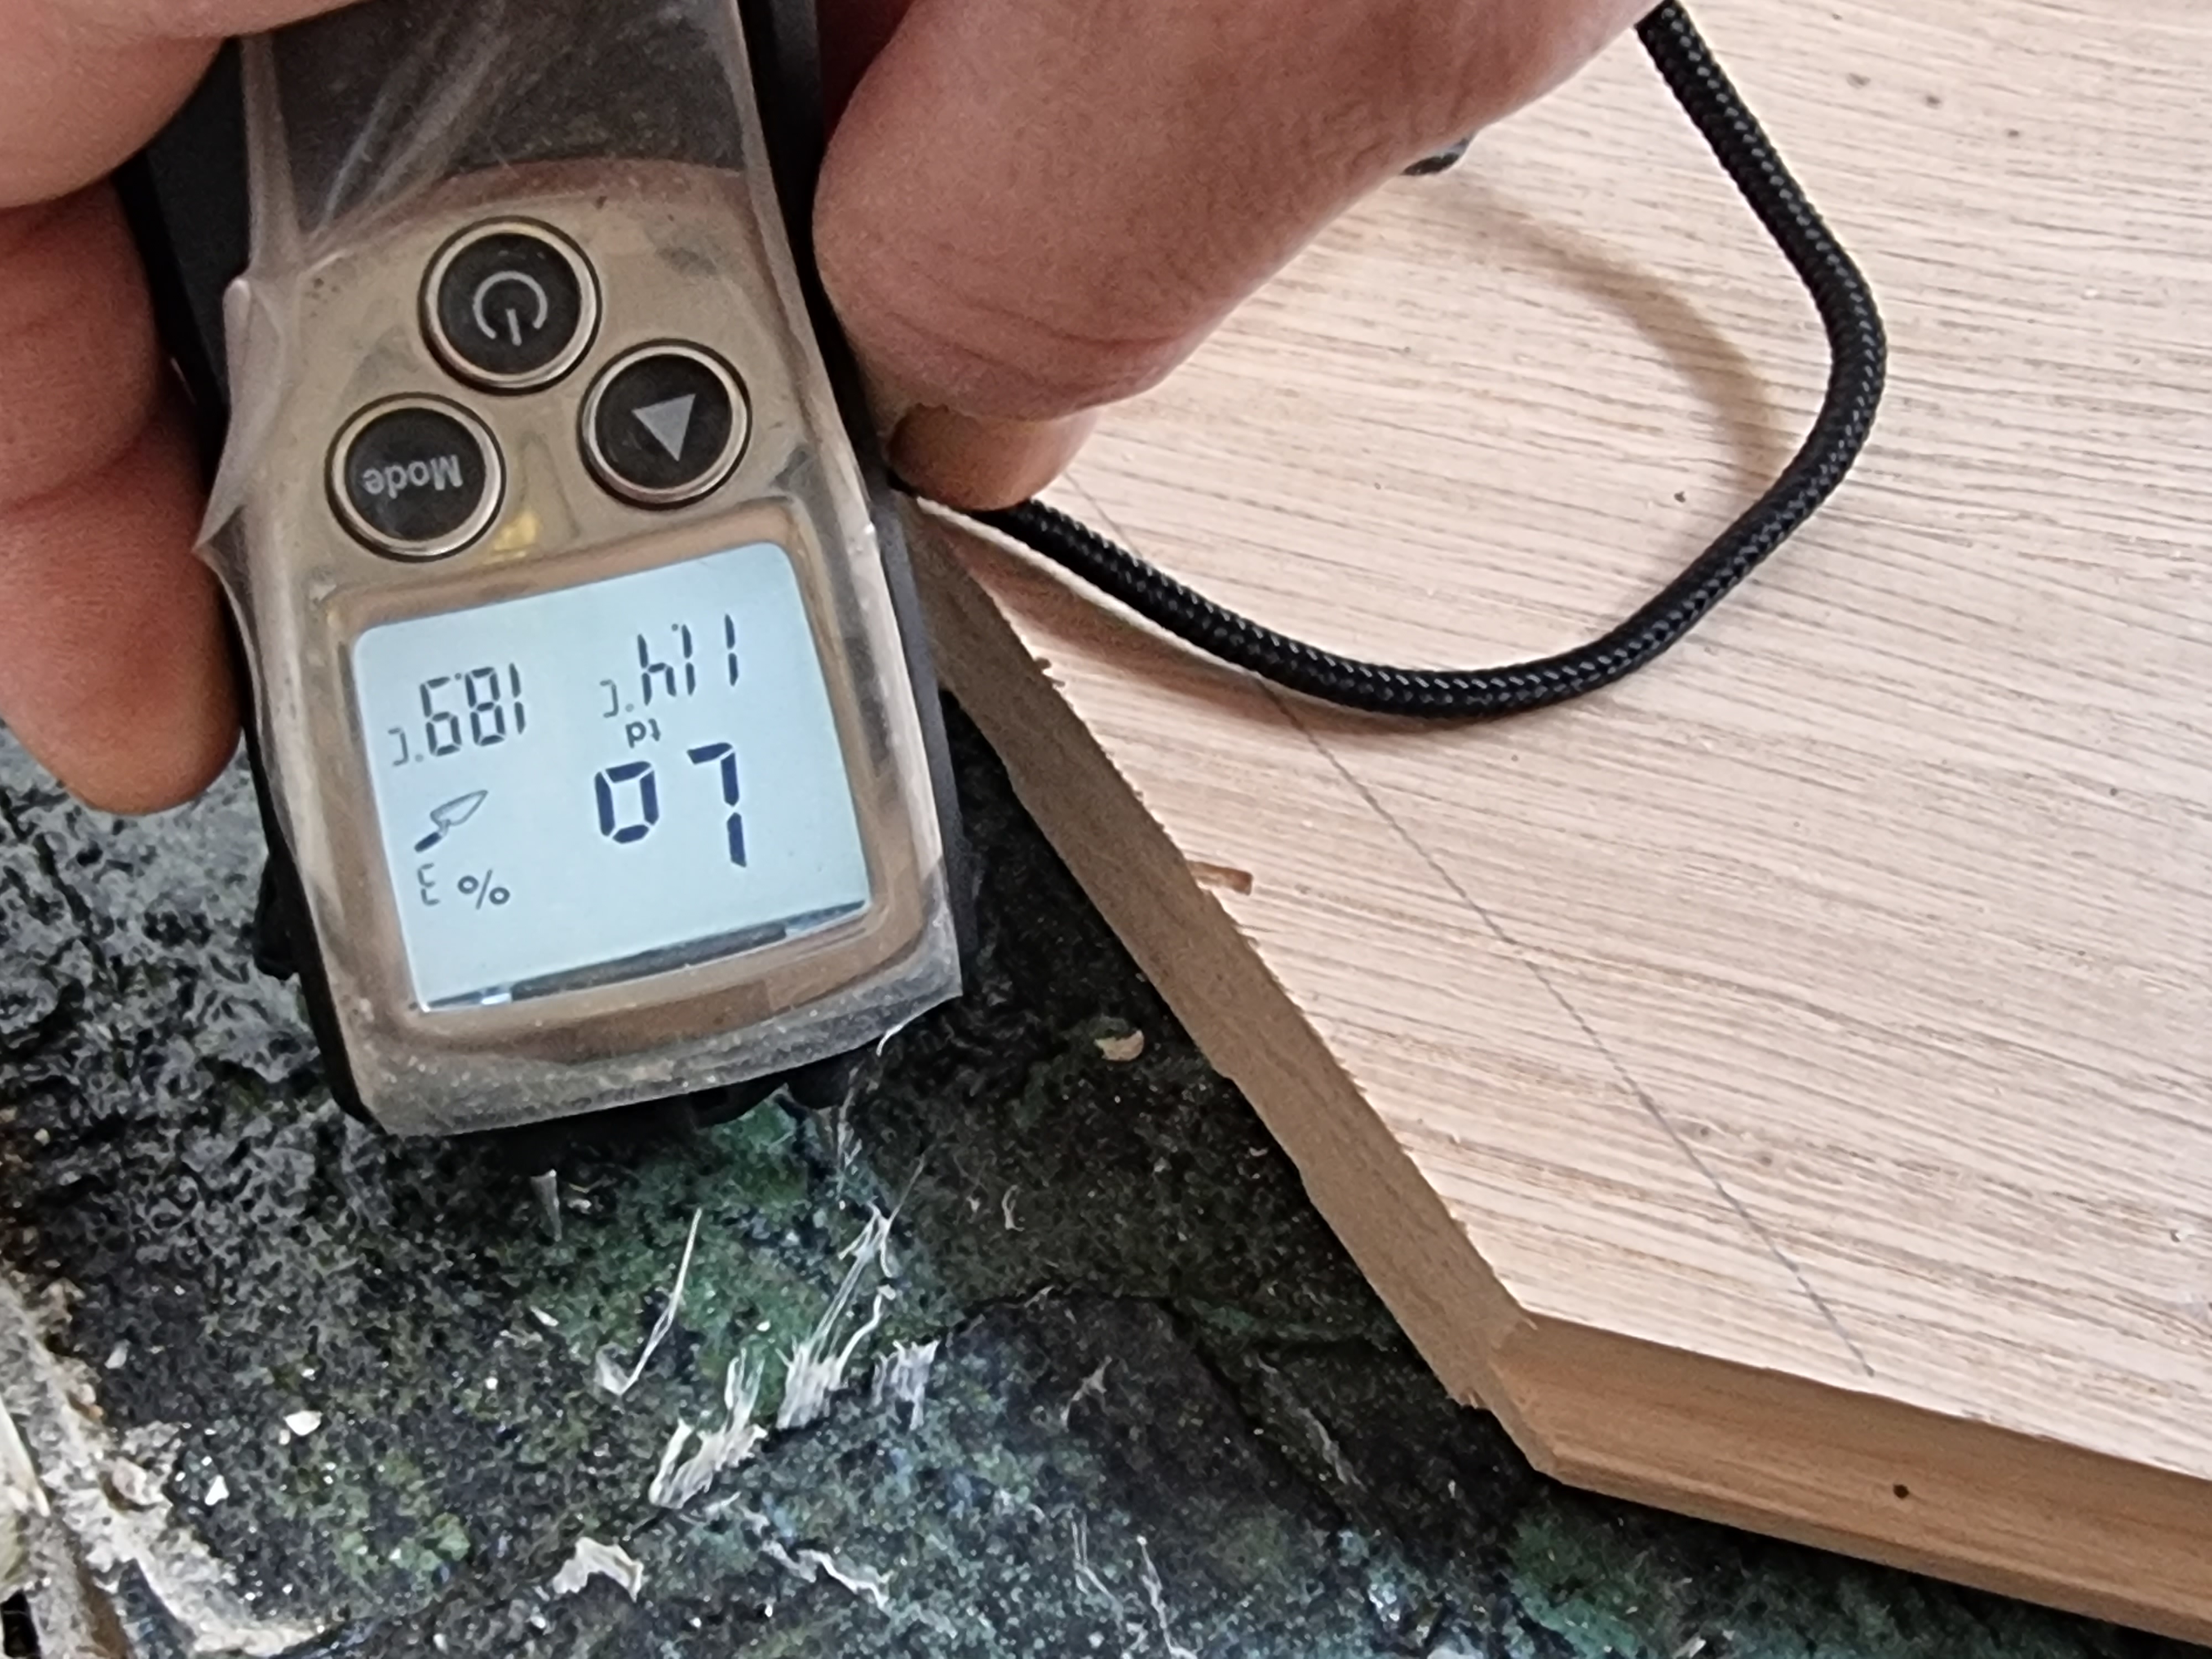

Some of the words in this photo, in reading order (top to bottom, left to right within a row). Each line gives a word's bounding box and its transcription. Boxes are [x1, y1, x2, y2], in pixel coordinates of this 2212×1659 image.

[361, 456, 463, 499] Mode
[625, 719, 661, 748] td
[595, 742, 747, 867] Lo
[457, 870, 510, 909] %
